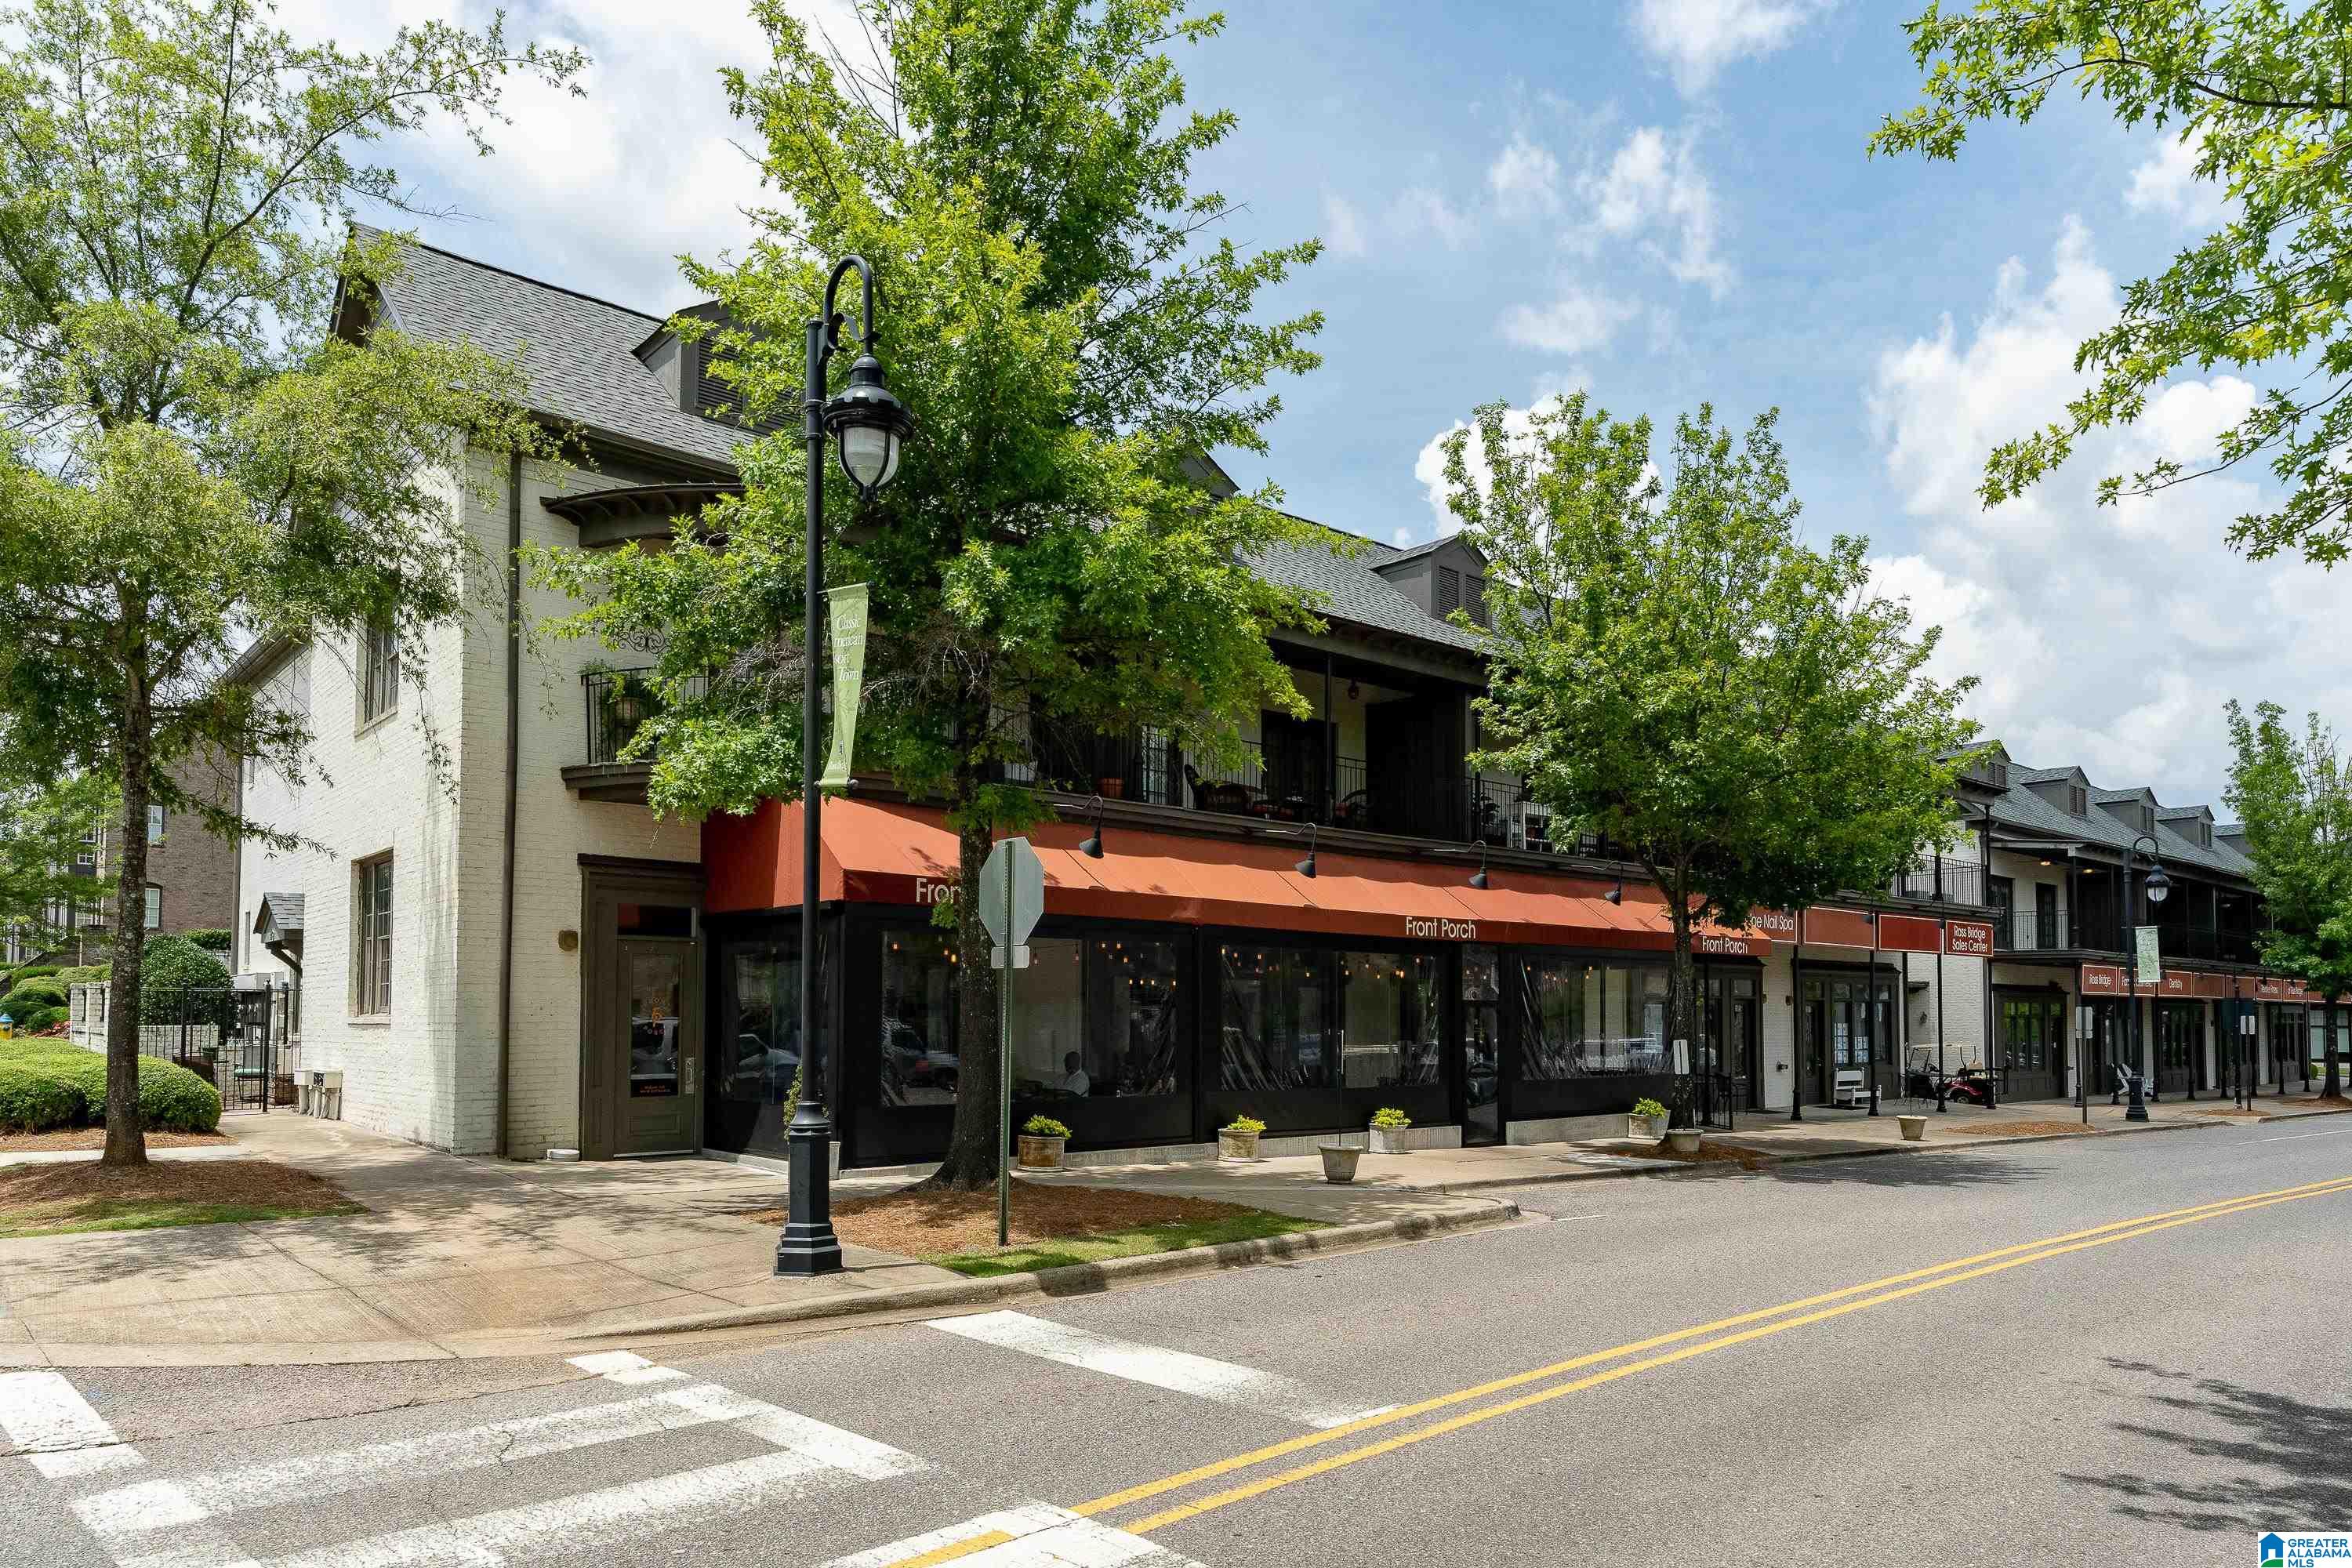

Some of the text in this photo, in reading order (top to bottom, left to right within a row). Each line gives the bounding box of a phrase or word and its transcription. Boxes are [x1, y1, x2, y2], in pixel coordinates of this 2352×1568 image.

[837, 667, 859, 681] Town
[916, 877, 962, 904] Fron
[1406, 916, 1476, 939] Front Porch
[1763, 914, 1778, 929] Nail
[1779, 915, 1794, 932] Spa
[1954, 924, 1986, 942] Ross Bridge
[1702, 936, 1748, 954] Front Porch
[1952, 938, 1988, 953] Sales Center
